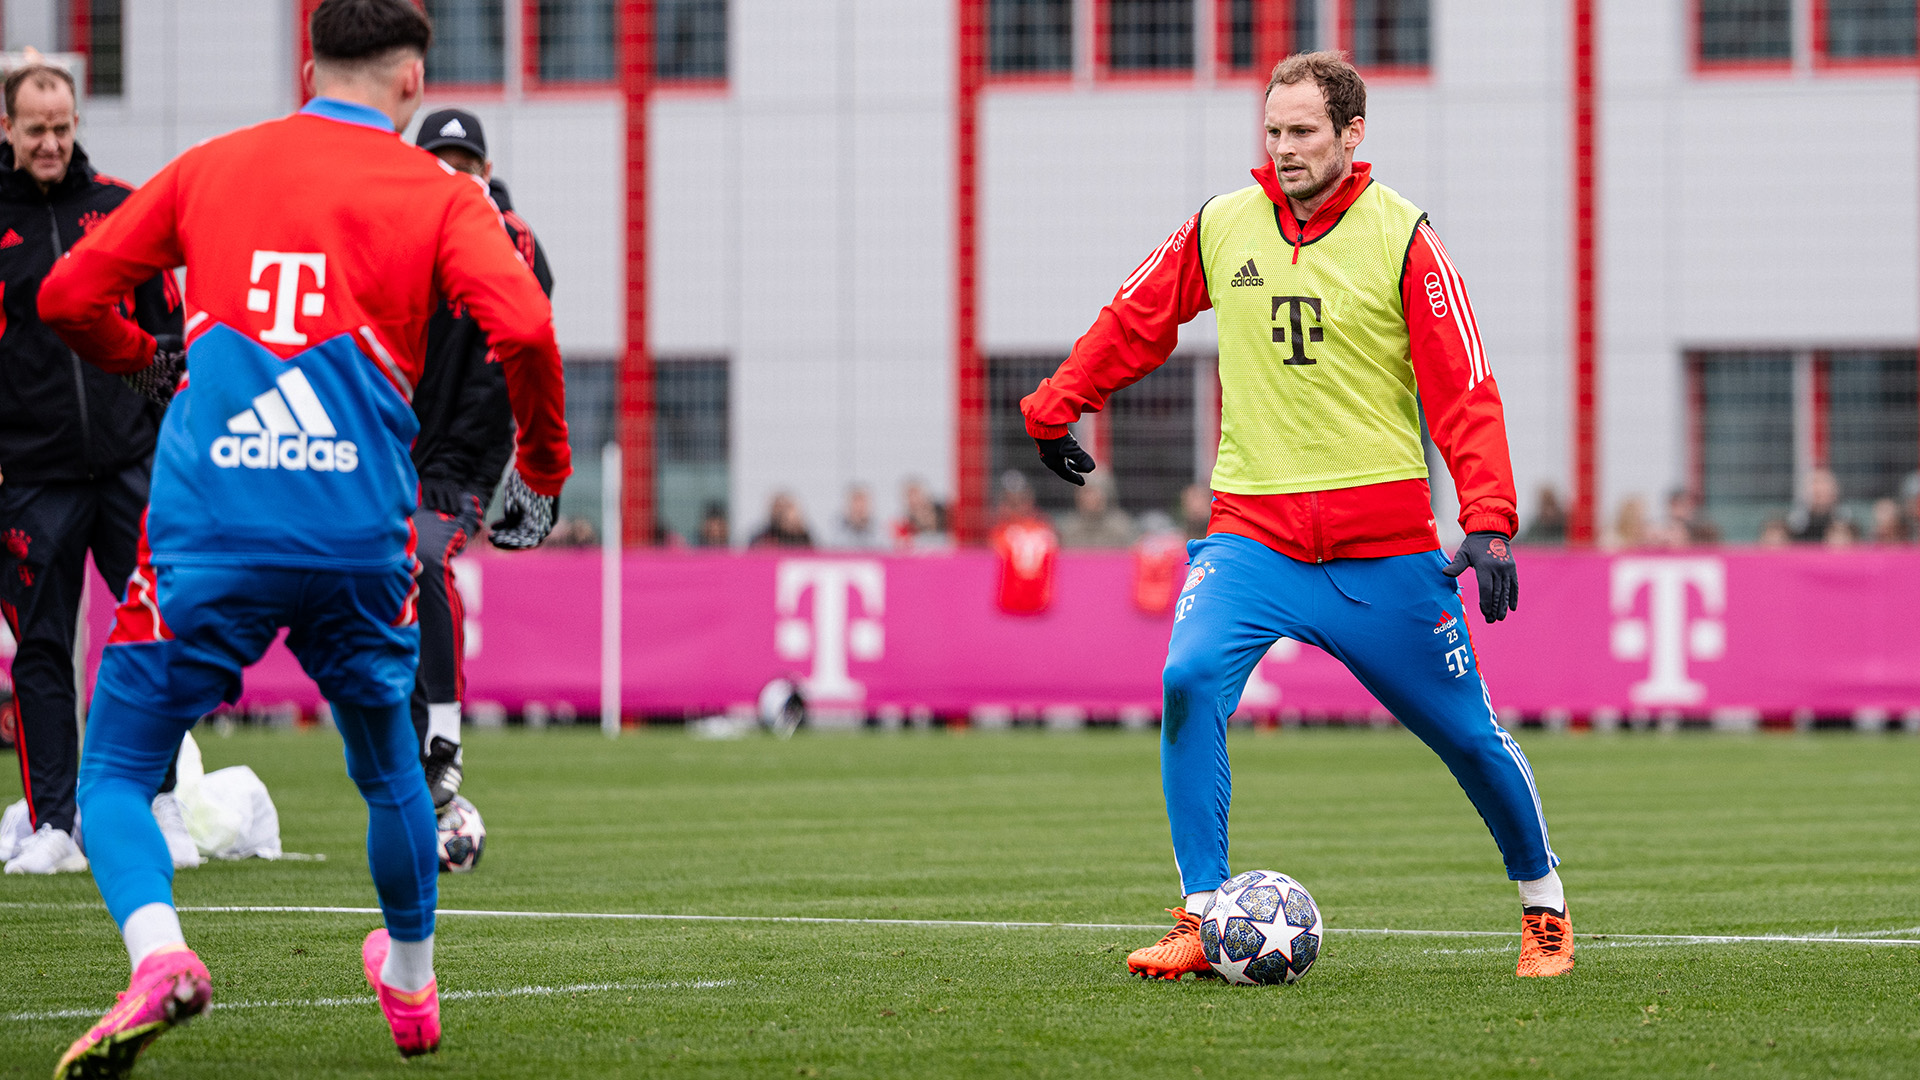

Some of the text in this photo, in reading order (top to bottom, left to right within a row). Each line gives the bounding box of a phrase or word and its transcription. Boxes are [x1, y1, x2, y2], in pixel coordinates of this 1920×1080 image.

[246, 250, 327, 345] T
[1231, 276, 1264, 287] adidas
[1271, 296, 1324, 366] T
[210, 430, 358, 473] adidas
[775, 559, 886, 702] T
[1434, 617, 1458, 634] adidas
[1446, 629, 1459, 645] 23
[1610, 557, 1726, 706] T
[1445, 644, 1470, 679] T
